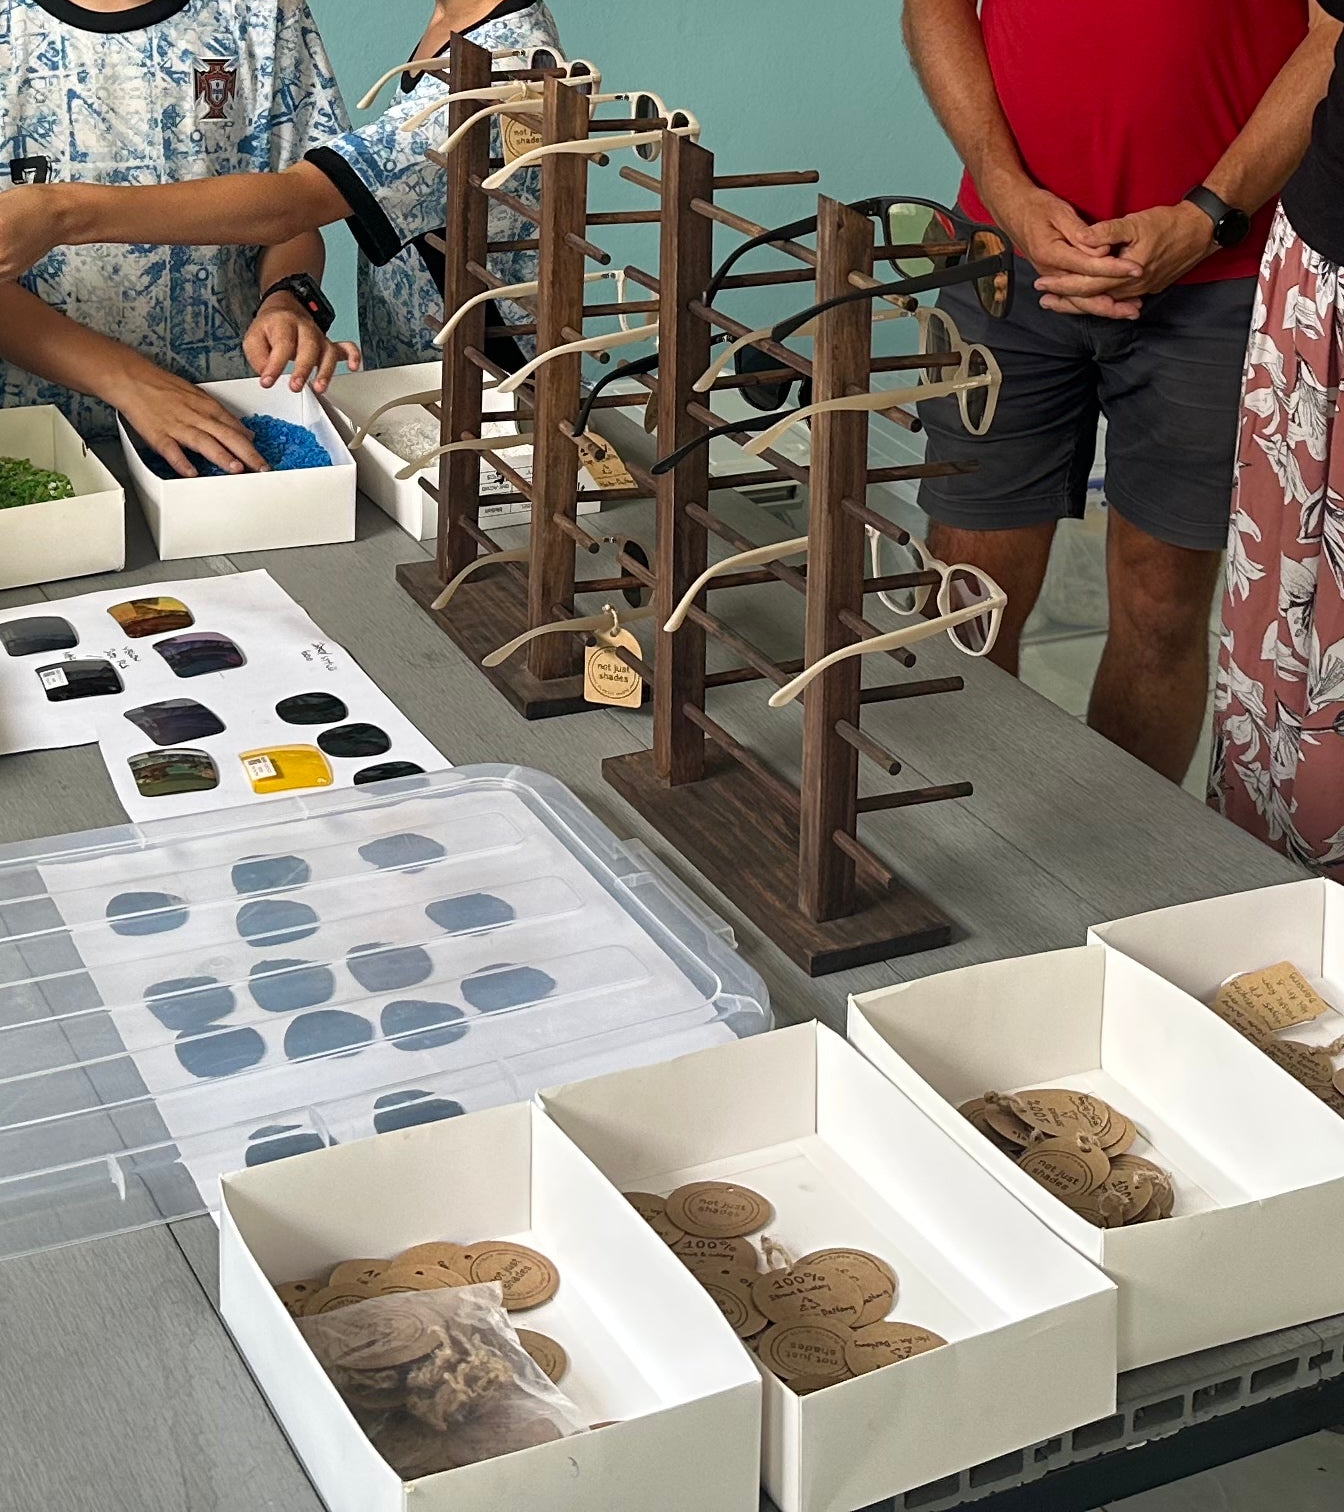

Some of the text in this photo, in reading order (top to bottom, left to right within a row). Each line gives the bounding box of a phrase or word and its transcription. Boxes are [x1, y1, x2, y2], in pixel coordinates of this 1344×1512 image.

[597, 663, 630, 674] not just
[599, 672, 629, 683] shades
[1032, 1167, 1070, 1191] shades
[1037, 1159, 1080, 1186] not just
[697, 1197, 719, 1207] not
[697, 1205, 741, 1218] shades
[683, 1239, 737, 1253] 100%
[501, 1258, 522, 1276] just
[772, 1271, 826, 1291] 100%
[790, 1341, 837, 1356] shades
[815, 1355, 838, 1365] not
